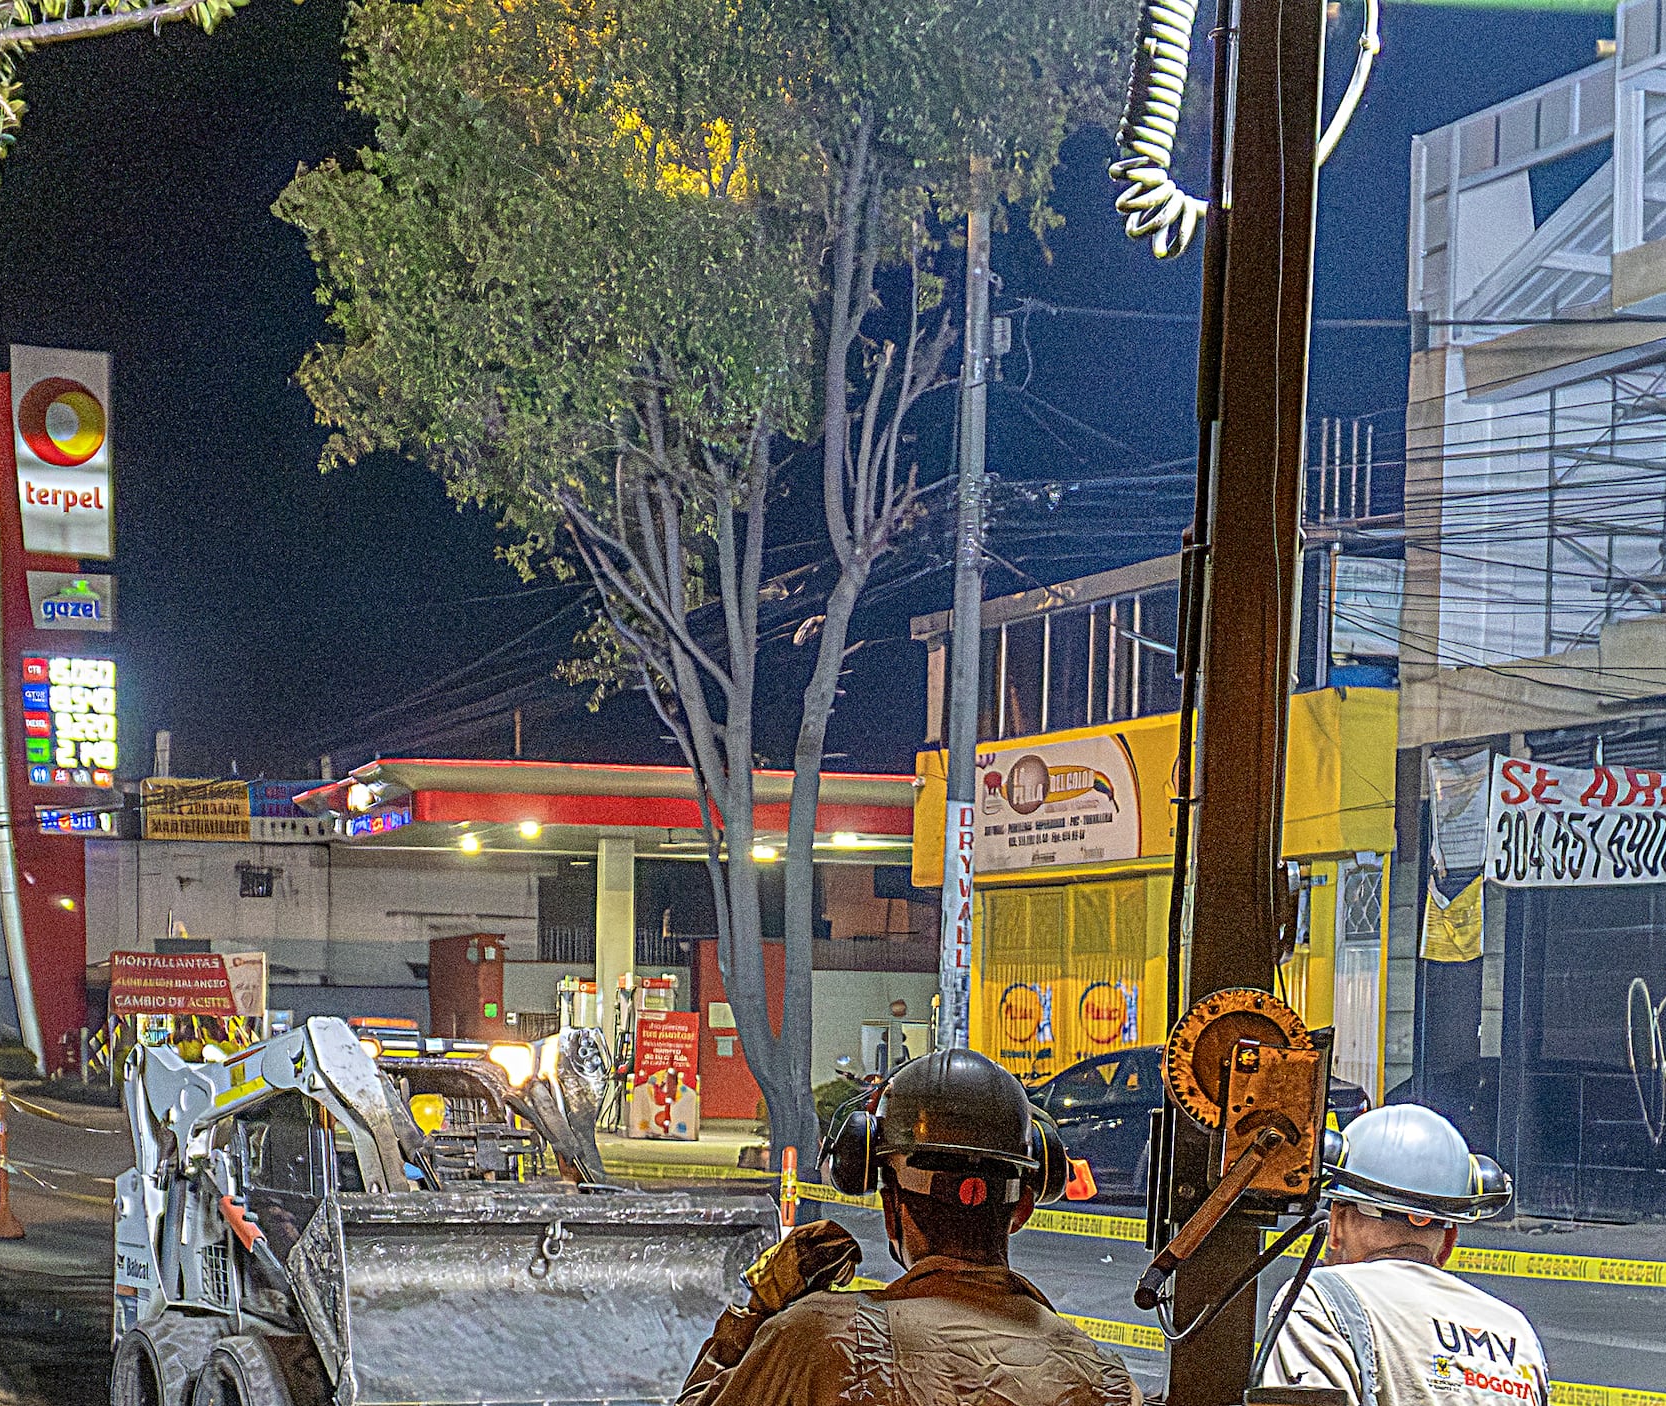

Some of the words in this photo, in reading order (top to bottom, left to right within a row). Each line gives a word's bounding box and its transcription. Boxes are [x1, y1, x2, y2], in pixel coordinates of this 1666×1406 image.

[25, 481, 104, 513] terpel
[42, 600, 101, 623] gazel
[1501, 759, 1563, 804] SE
[1495, 809, 1546, 881] 304
[955, 807, 974, 968] DRYWALL
[114, 954, 221, 969] MONTALLANTAS
[114, 995, 166, 1008] CAMBIO
[168, 996, 183, 1007] DE
[187, 997, 230, 1009] ACEITE
[1432, 1317, 1517, 1367] UMV
